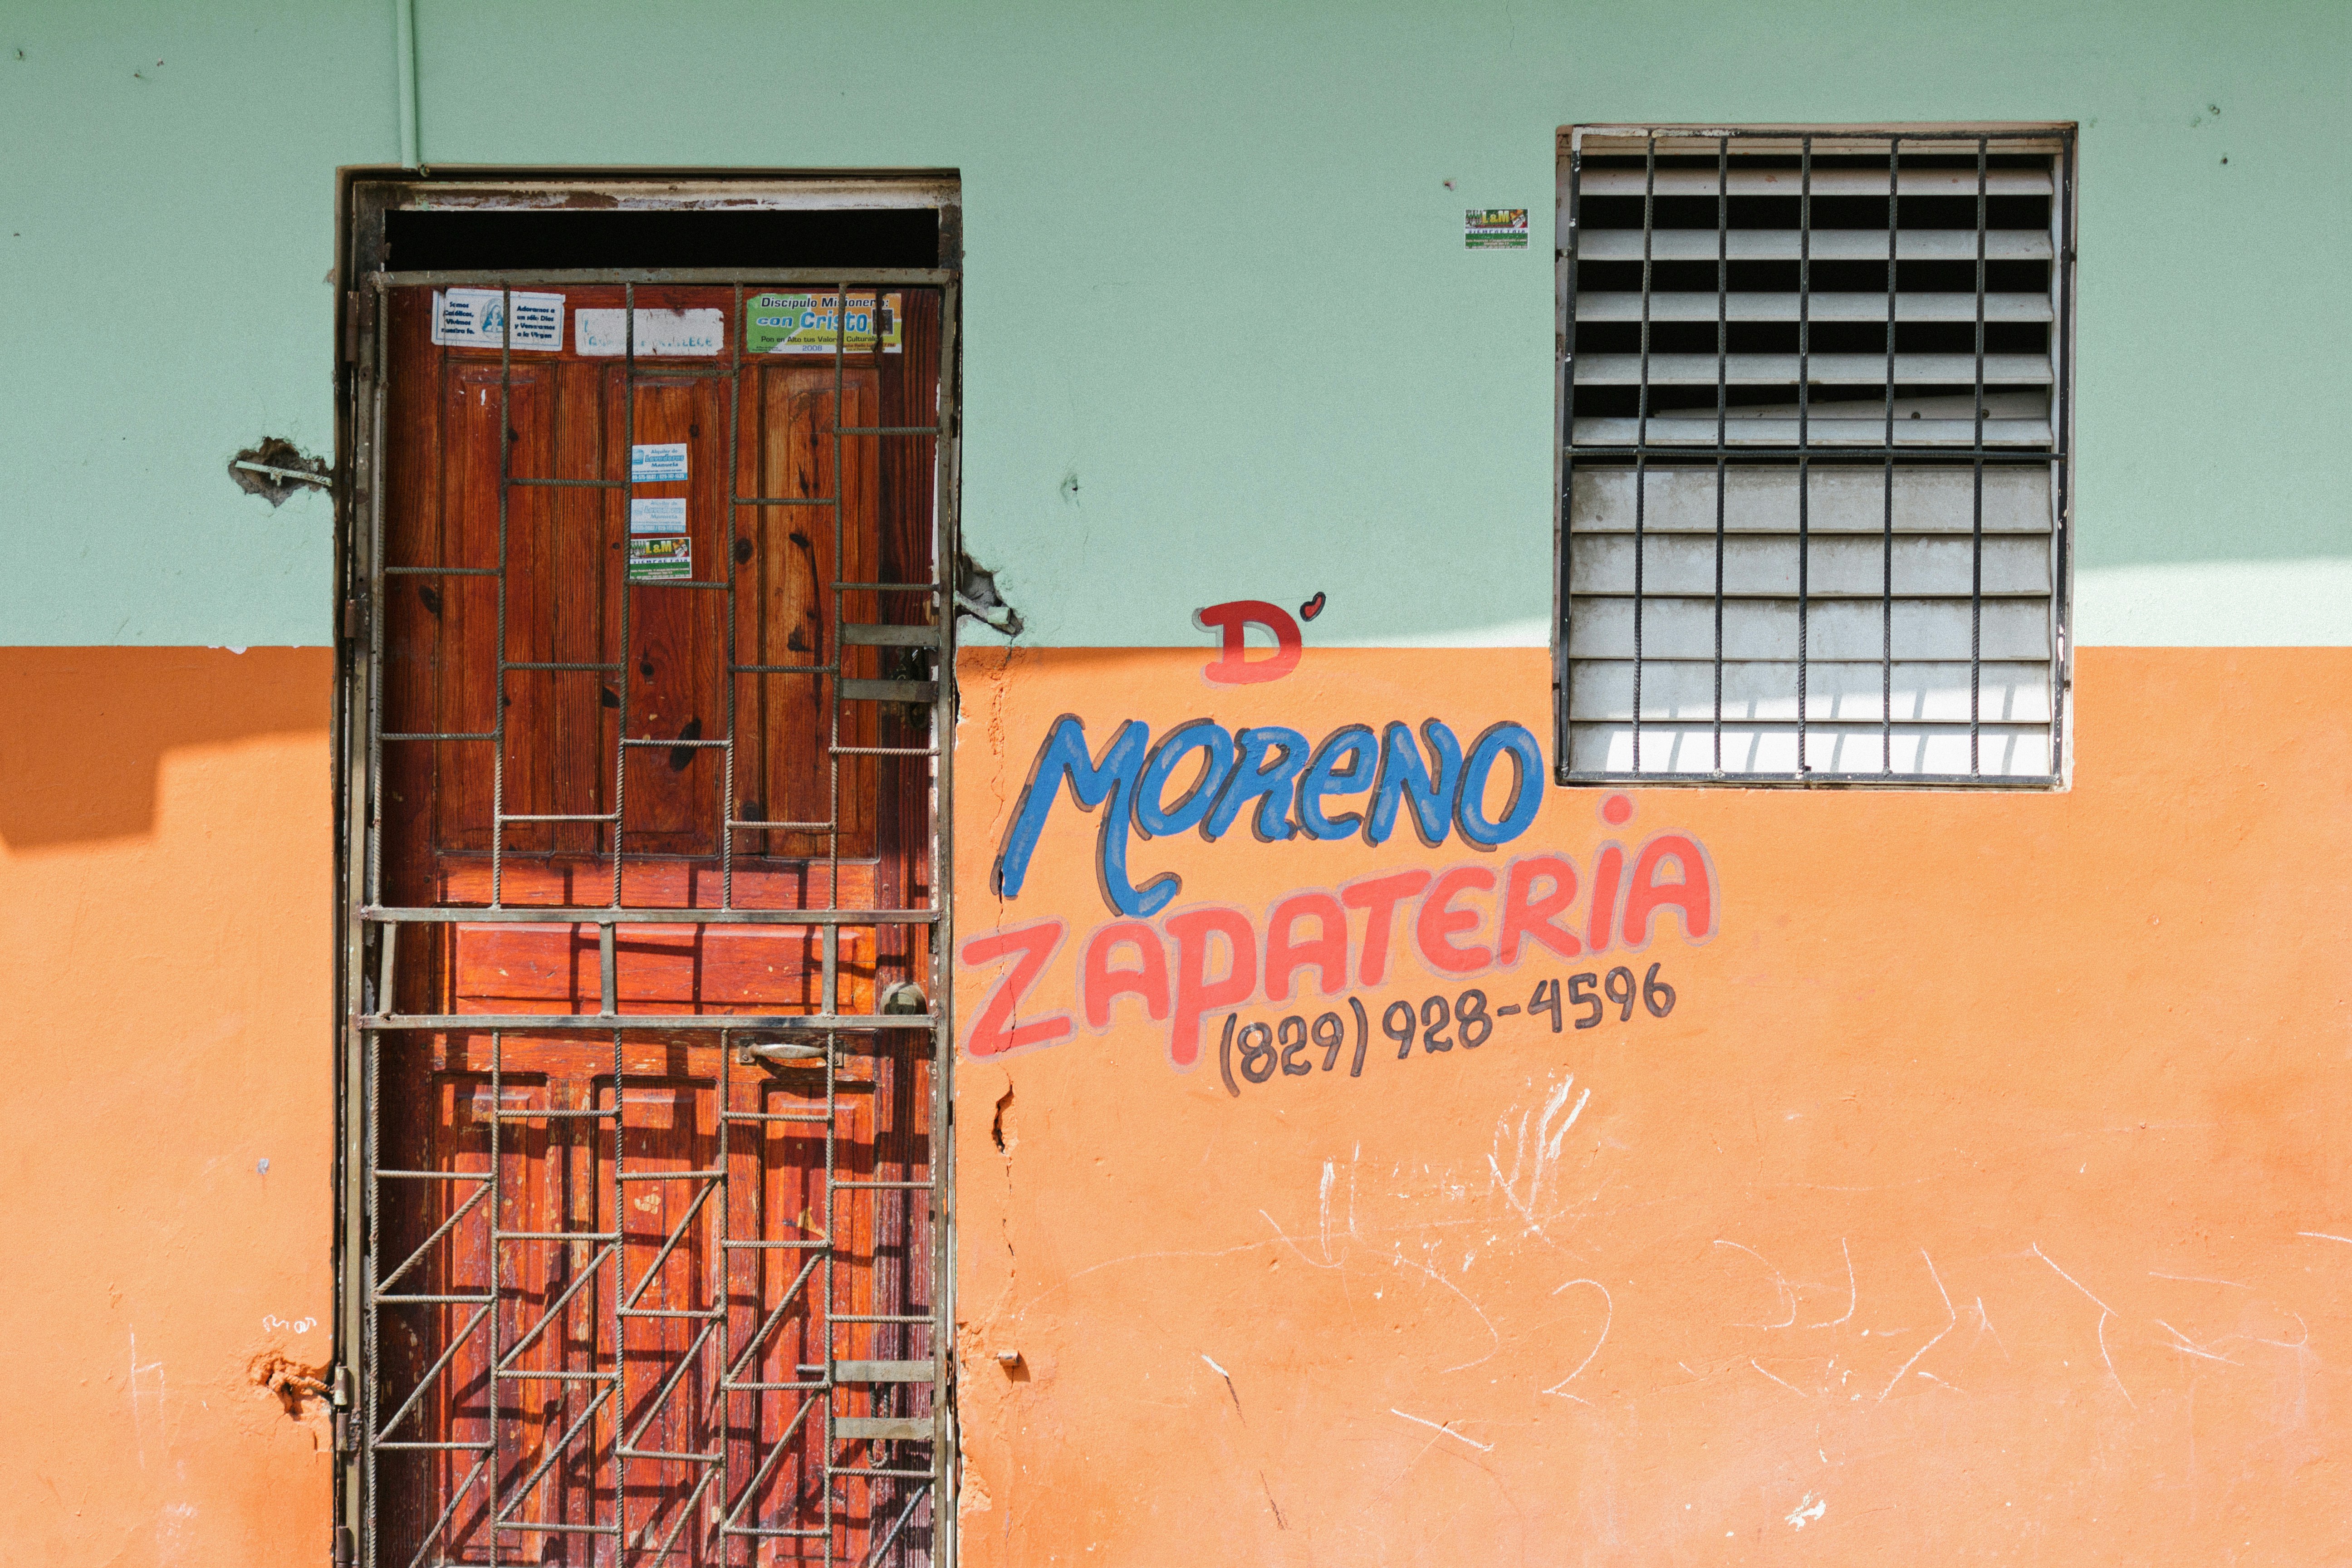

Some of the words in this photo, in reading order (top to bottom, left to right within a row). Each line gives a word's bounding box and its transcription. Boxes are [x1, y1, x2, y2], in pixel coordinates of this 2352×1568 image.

[761, 297, 817, 309] Discípulo
[821, 297, 889, 307] Miioner:
[757, 317, 793, 328] con
[646, 540, 672, 554] L&M
[1220, 996, 1367, 1098] (829)
[1382, 962, 1676, 1059] 928-4596
